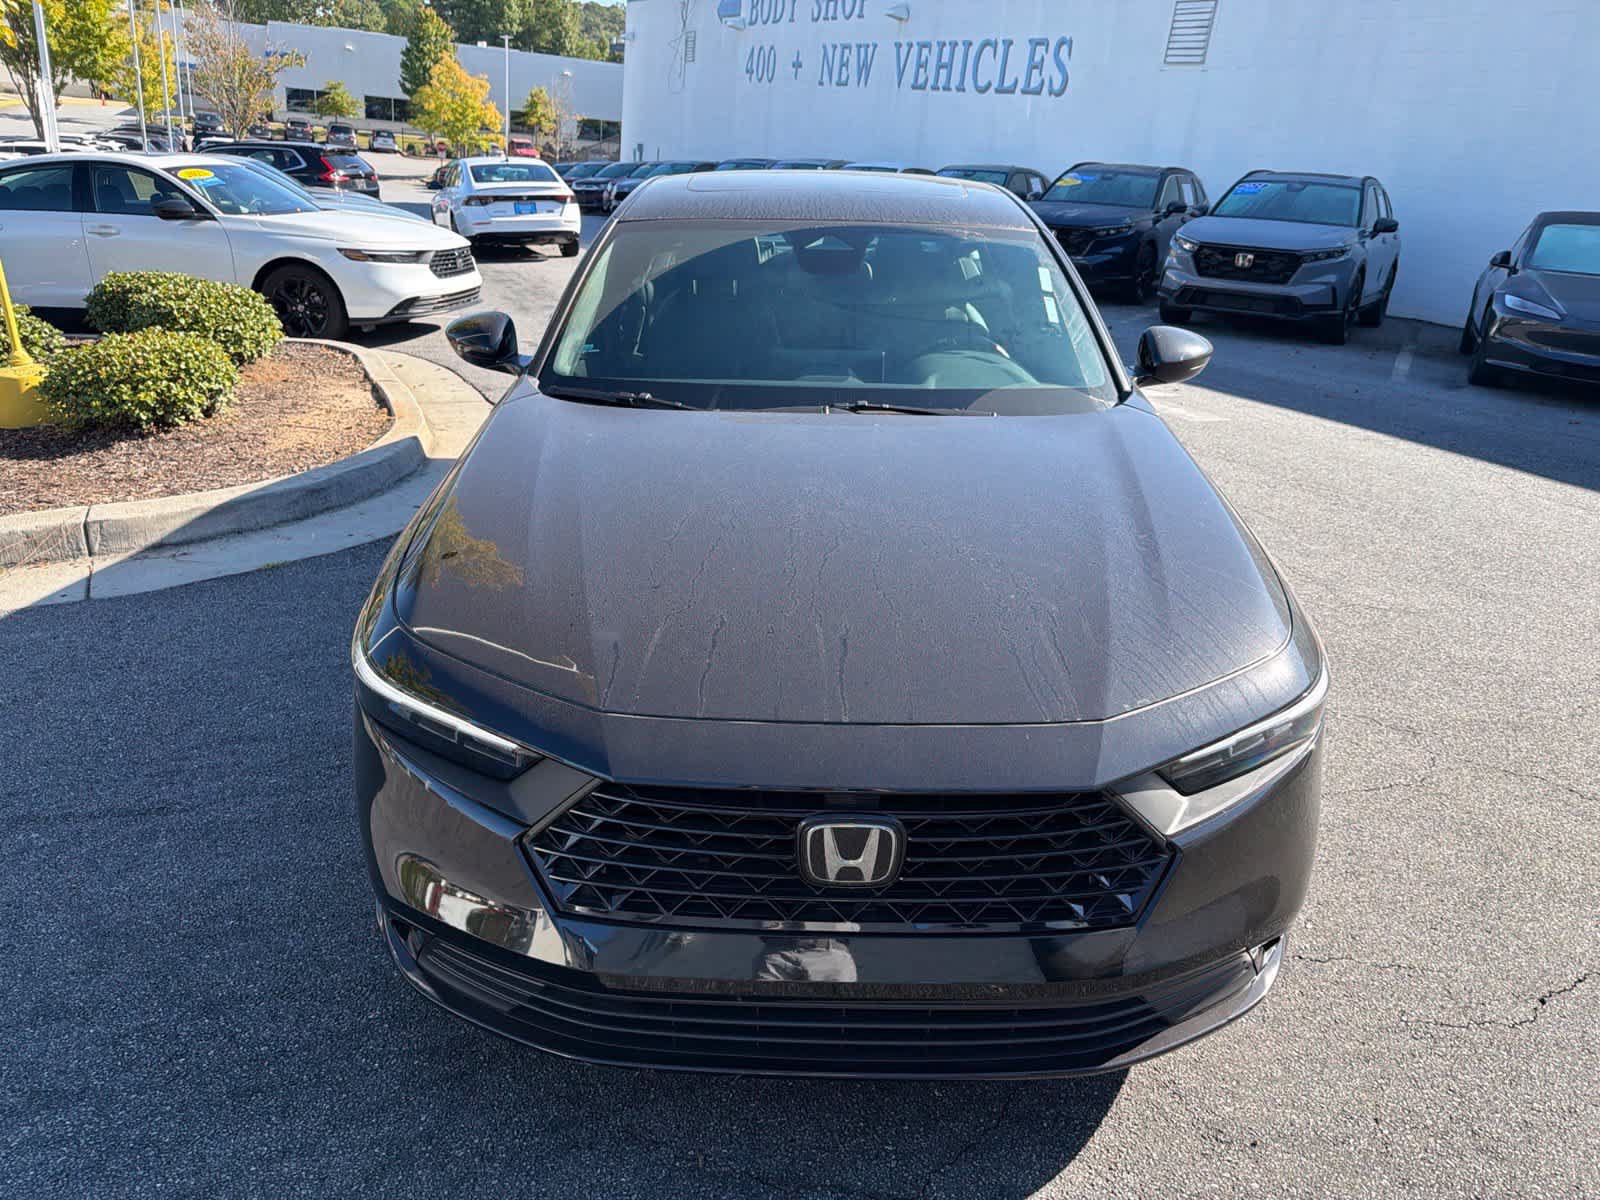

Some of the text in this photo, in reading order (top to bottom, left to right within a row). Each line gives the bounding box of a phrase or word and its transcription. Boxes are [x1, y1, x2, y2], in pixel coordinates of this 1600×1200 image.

[748, 0, 797, 26] BODY
[746, 45, 777, 83] 400
[818, 42, 878, 87] NEW
[894, 36, 1073, 97] VEHICLES
